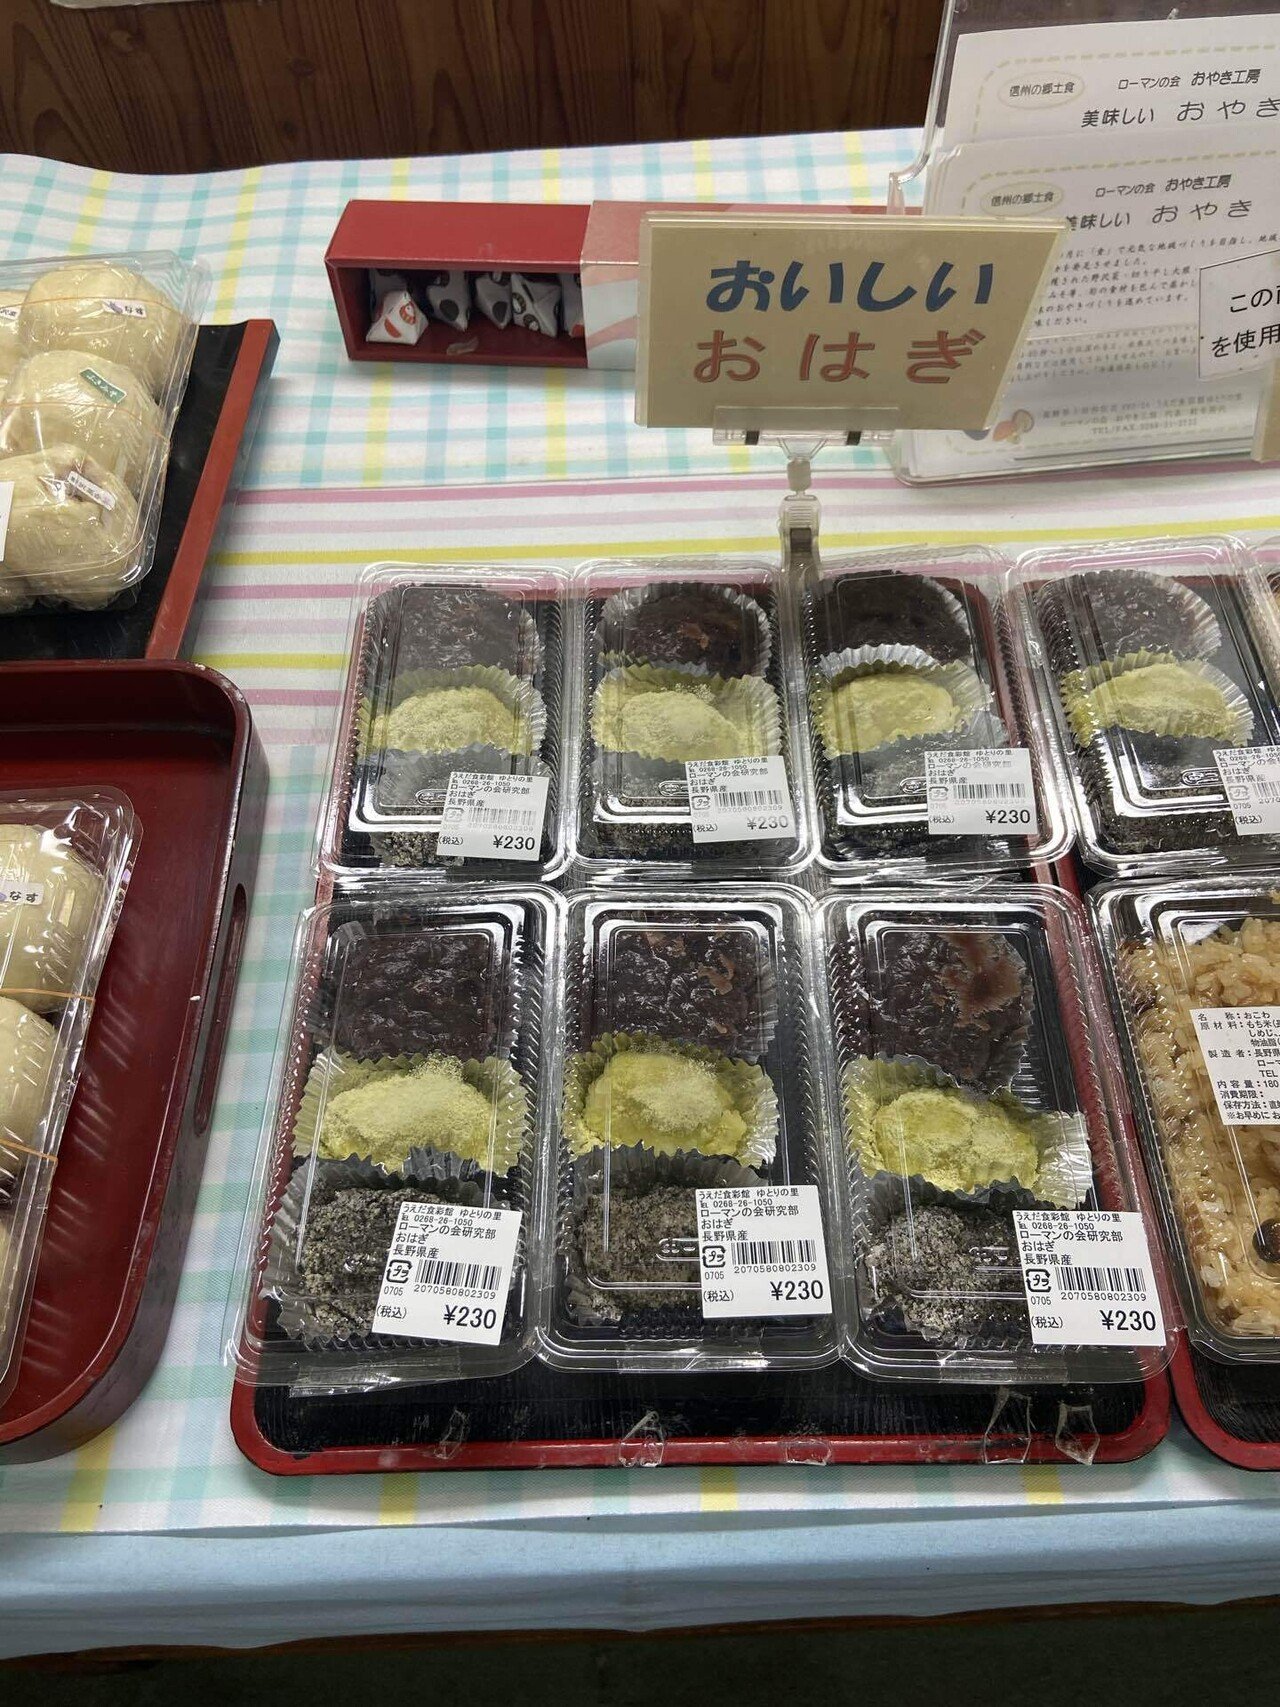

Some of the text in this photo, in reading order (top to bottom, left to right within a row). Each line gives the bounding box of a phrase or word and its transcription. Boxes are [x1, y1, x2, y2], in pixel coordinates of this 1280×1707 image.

[1118, 68, 1262, 90] ローマンの会 おやき工房
[1009, 81, 1075, 98] 信州の郷土食
[1081, 107, 1154, 128] 美味しい
[1095, 174, 1232, 198] ローマンの会 おやき工房
[1152, 200, 1252, 225] おやき
[705, 260, 994, 312] おいしい
[1230, 284, 1280, 313] この
[693, 328, 986, 384] おはぎ
[448, 790, 476, 798] おはぎ
[747, 815, 789, 830] ¥230
[985, 809, 1031, 824] ¥230
[493, 835, 535, 850] ¥230
[10, 891, 38, 903] なす
[1258, 1070, 1278, 1078] TEL
[699, 1188, 799, 1200] うえだ食彩館 ゆとりの里
[713, 1199, 773, 1208] 0268-26-1050
[402, 1204, 502, 1221] うえだ食彩館 ゆとりの里
[701, 1205, 799, 1217] ローマンの会研究部
[414, 1215, 473, 1226] 0268-26-1050
[1016, 1212, 1122, 1223] うえだ食彩館 ゆとりの里
[701, 1218, 734, 1230] おはぎ
[1032, 1222, 1095, 1230] 0268-26-1050
[398, 1222, 497, 1240] ローマンの会研究部
[702, 1230, 748, 1242] 長野県産
[1020, 1230, 1124, 1242] ローマンの会研究部
[395, 1232, 429, 1244] おはぎ
[392, 1244, 439, 1259] 長野県産
[1022, 1240, 1055, 1252] おはぎ
[1024, 1254, 1073, 1265] 長野県産
[734, 1263, 816, 1274] 2070580802309
[704, 1271, 725, 1280] 0705
[383, 1286, 404, 1296] 0705
[414, 1284, 496, 1300] 2070580802309
[703, 1280, 824, 1303] (税込) ¥230
[1060, 1292, 1147, 1302] 2070580802309
[1030, 1296, 1051, 1306] 0705
[377, 1305, 497, 1329] (税込) ¥230
[1030, 1309, 1156, 1331] (税込) ¥230
